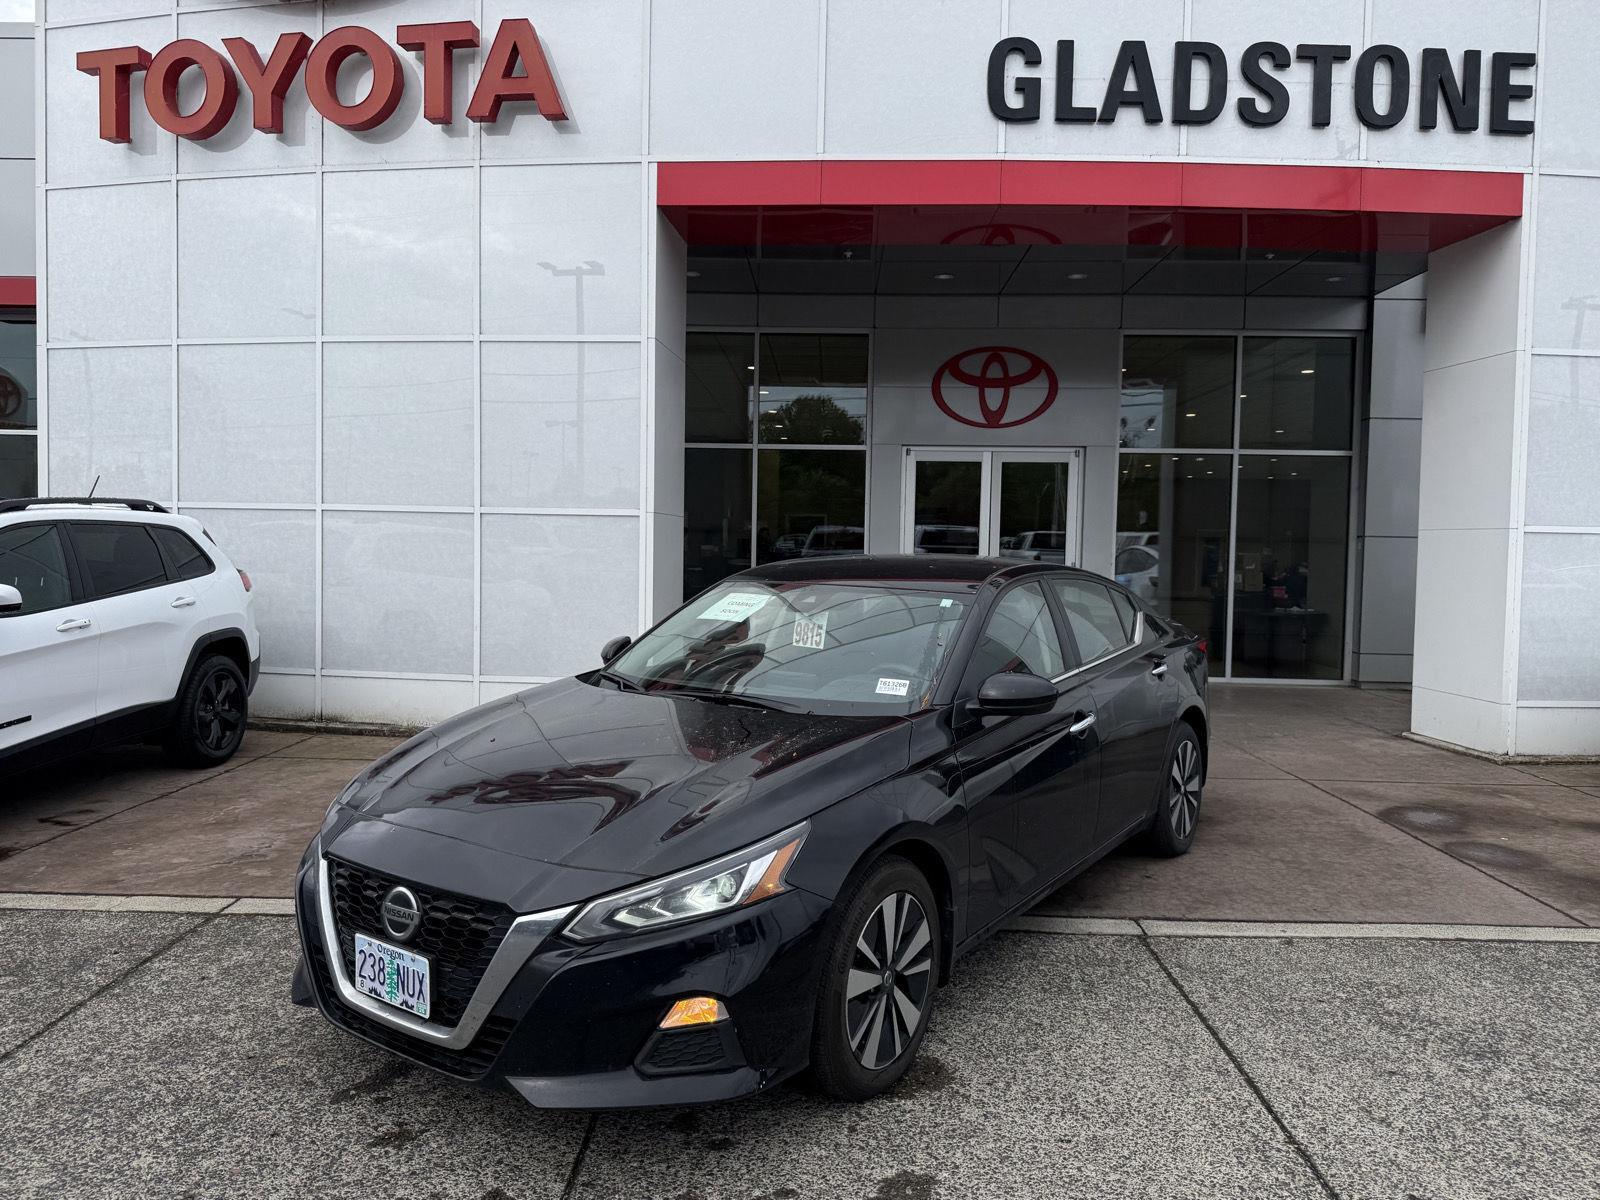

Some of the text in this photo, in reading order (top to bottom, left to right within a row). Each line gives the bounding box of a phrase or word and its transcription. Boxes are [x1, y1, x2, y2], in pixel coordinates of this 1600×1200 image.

[76, 18, 569, 144] TOYOTA
[986, 37, 1537, 134] GLADSTONE
[794, 622, 824, 648] 9815
[384, 905, 415, 922] NISSAN
[376, 944, 405, 961] Oregon
[359, 949, 426, 1003] 238 NUX
